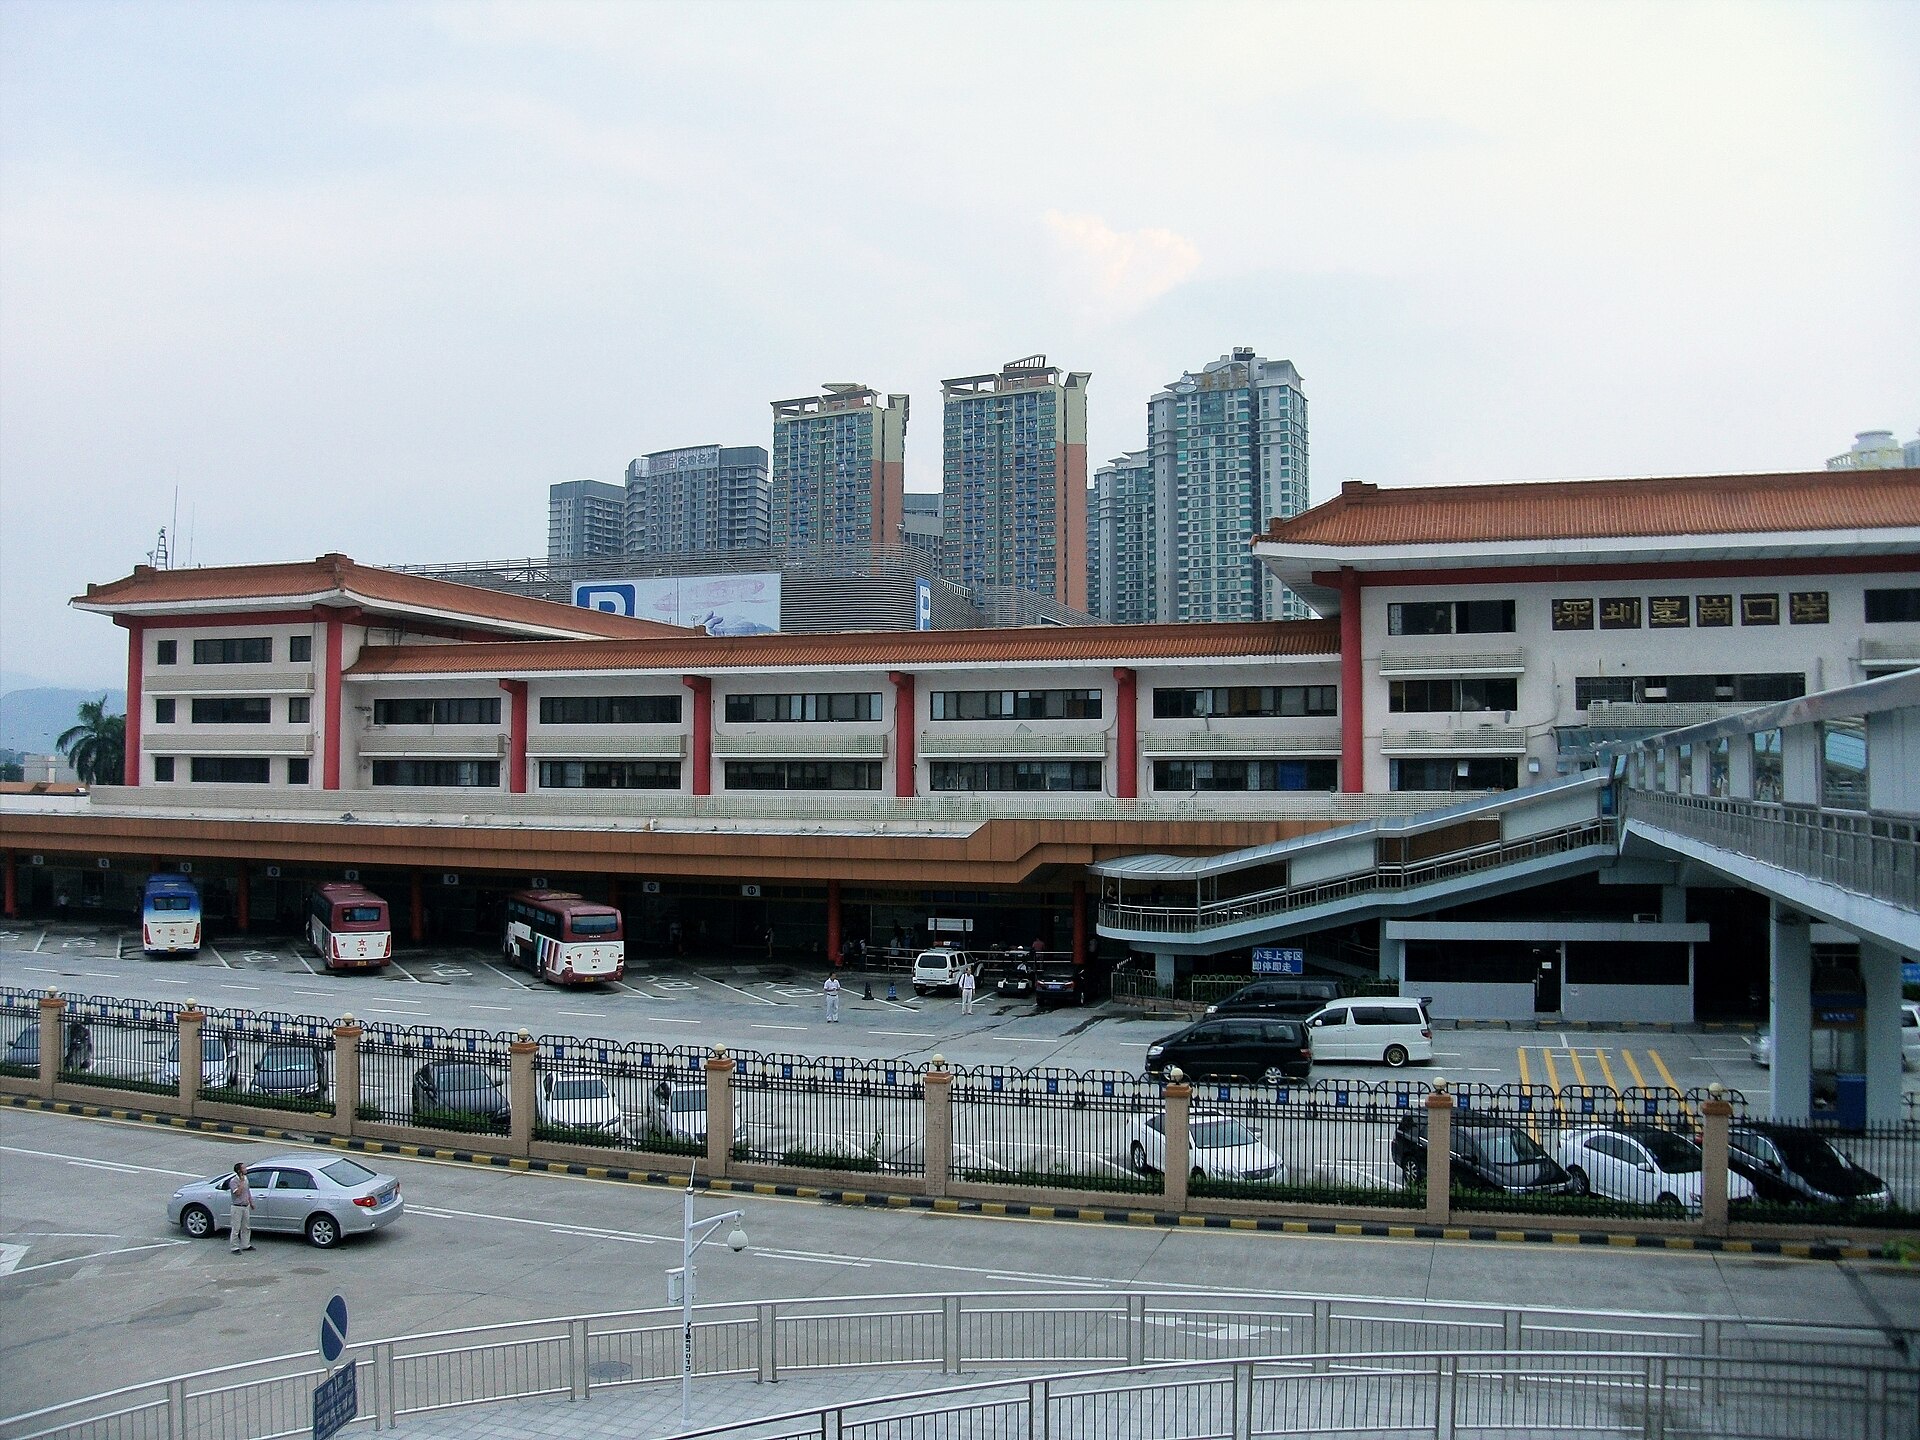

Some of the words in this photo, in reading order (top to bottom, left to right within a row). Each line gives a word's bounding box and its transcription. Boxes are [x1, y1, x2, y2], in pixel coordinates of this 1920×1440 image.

[920, 585, 931, 631] P
[1252, 950, 1303, 961] 小车上客区
[1252, 961, 1292, 972] 即停即走
